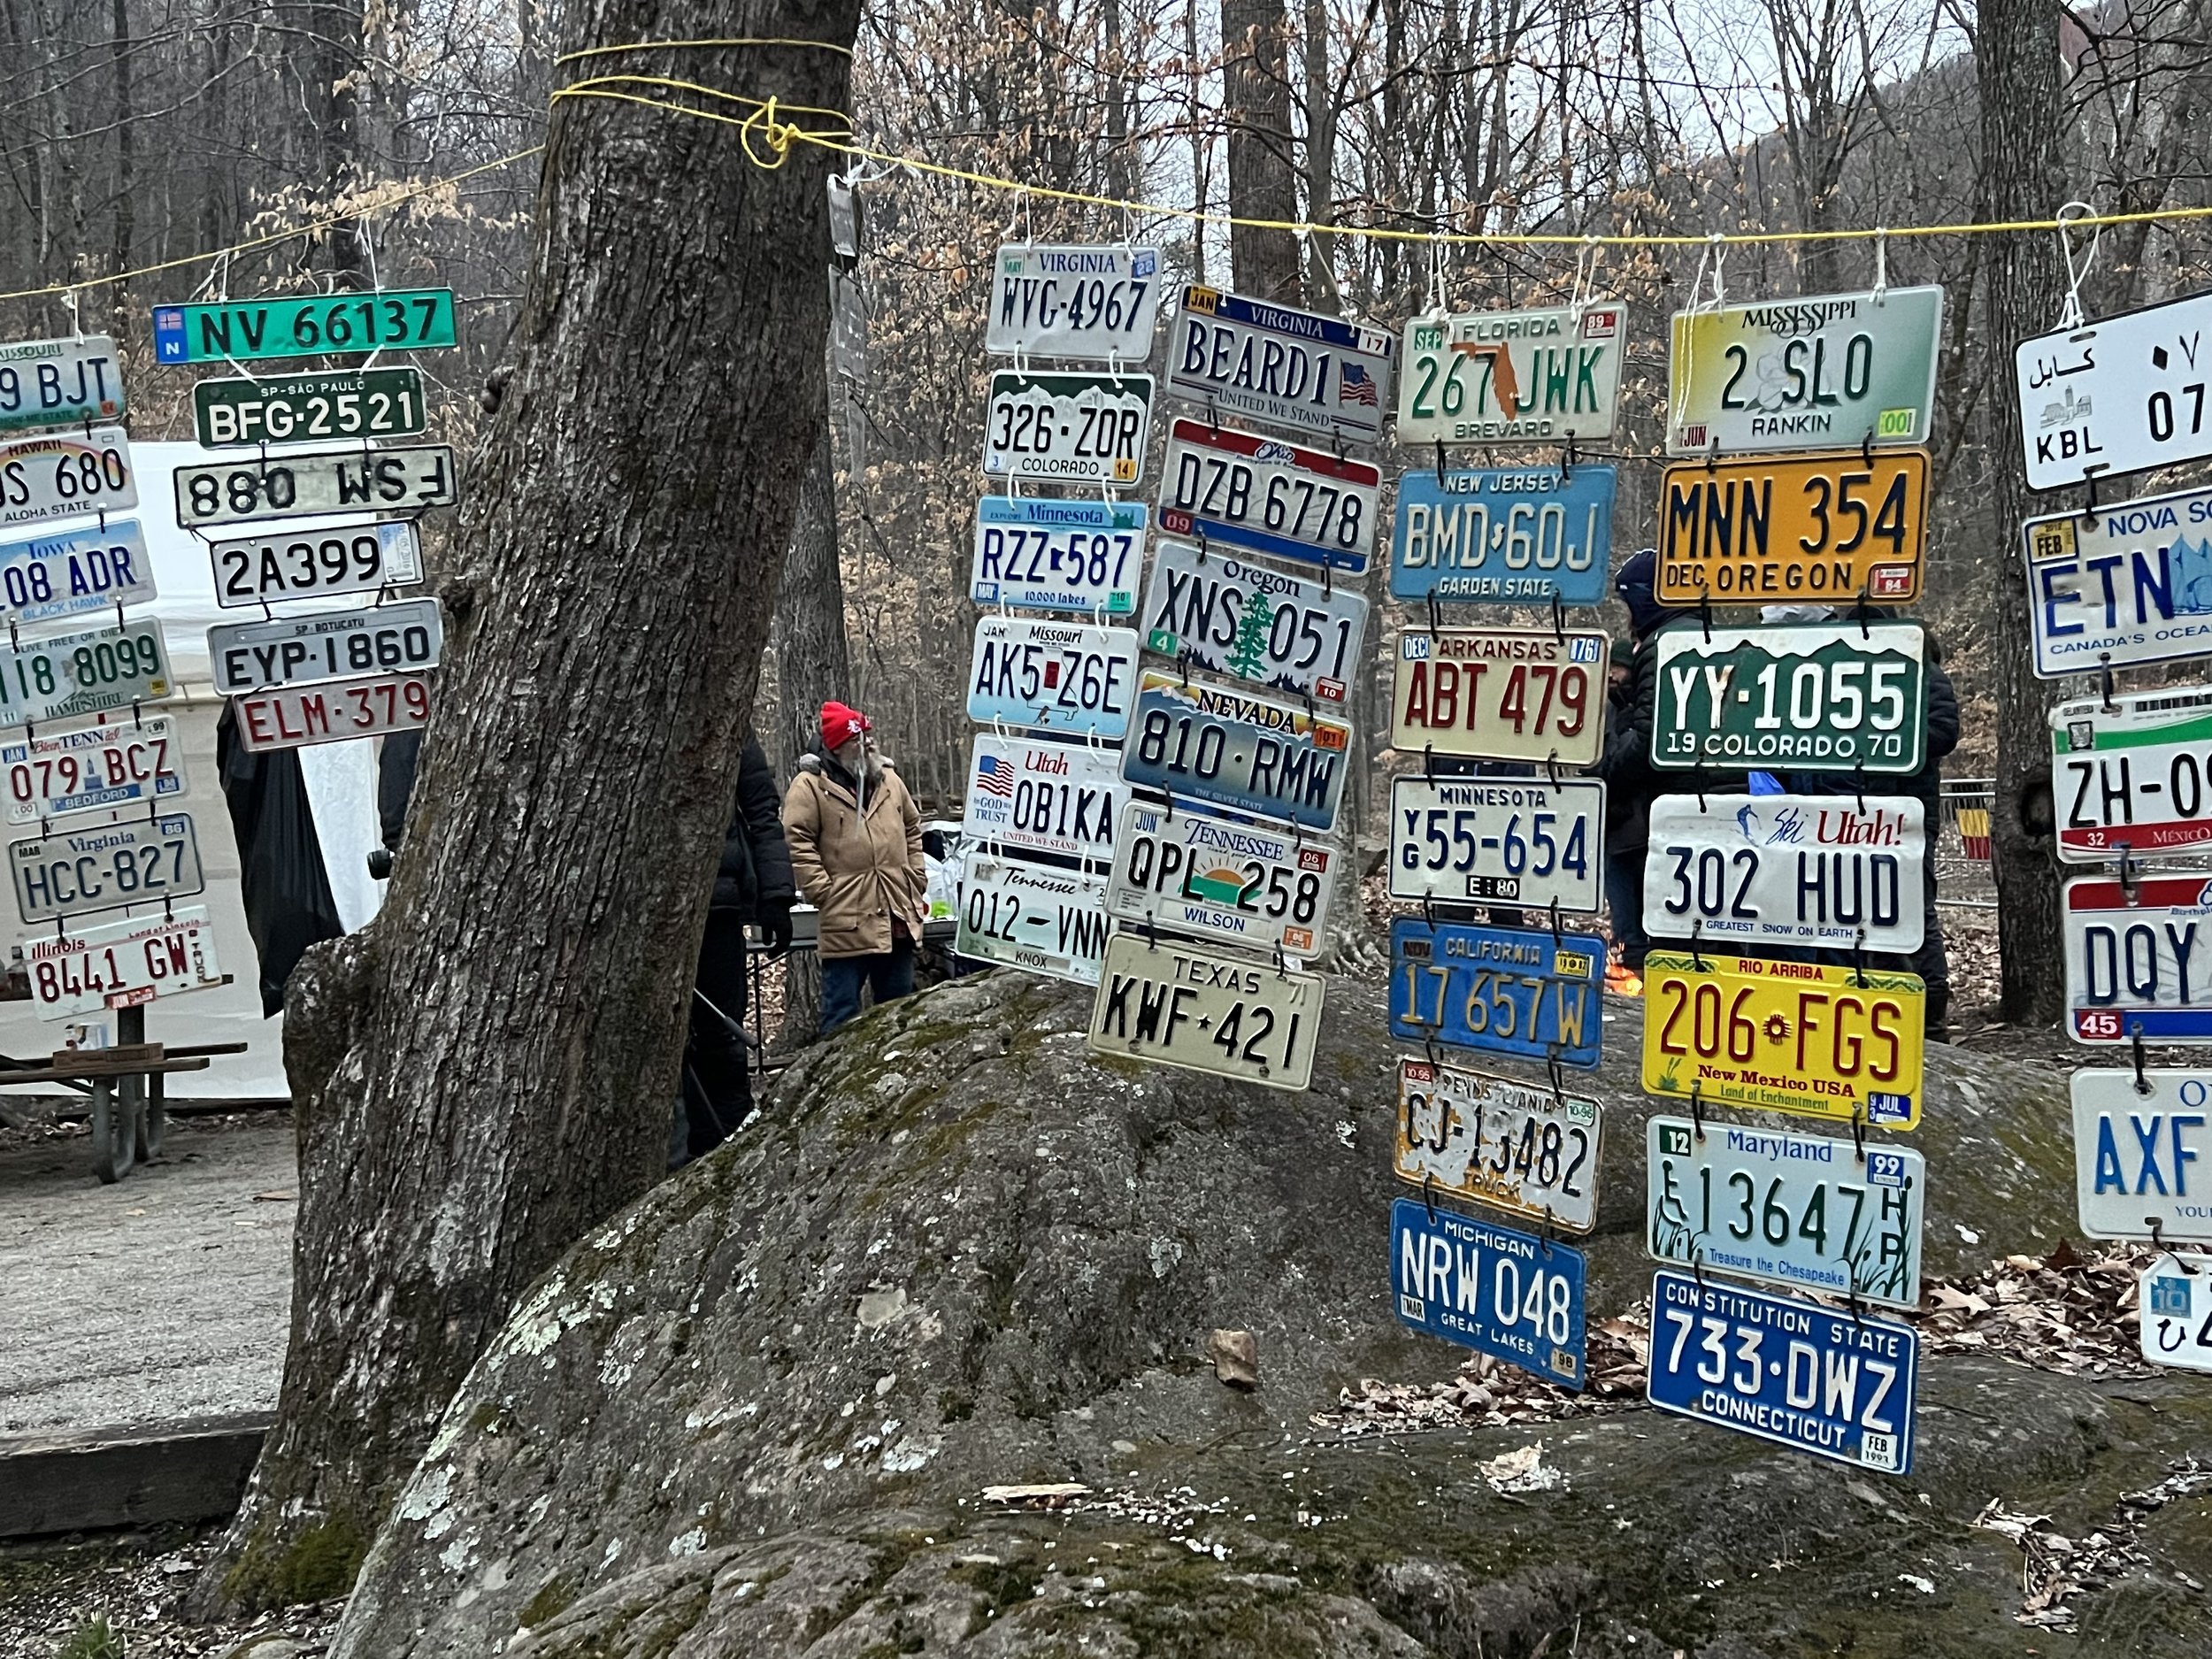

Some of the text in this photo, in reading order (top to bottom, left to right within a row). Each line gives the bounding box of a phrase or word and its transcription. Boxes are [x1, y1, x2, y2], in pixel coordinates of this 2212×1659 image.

[1004, 253, 1116, 274] MAY VIRGINIA
[200, 297, 438, 354] NV 66137
[1190, 293, 1325, 339] JAN VIRGINIA
[1417, 319, 1561, 350] SEP FLORIDA
[1181, 319, 1331, 406] BEARD1
[1515, 342, 1604, 414] JWK
[37, 356, 108, 409] BJT
[321, 381, 365, 394] PAULO
[1218, 389, 1331, 427] UNITED WE STAND
[1455, 419, 1554, 438] BREVARD
[1683, 413, 1832, 448] JUN RANKIN
[2037, 426, 2103, 465] KBL
[8, 440, 61, 457] HAWAII
[1022, 457, 1129, 475] COLORADO 14
[1256, 442, 1294, 461] Ohio
[56, 448, 125, 498] 680
[1445, 472, 1563, 494] NEW JERSEY
[5, 501, 91, 522] ALOHA STATE
[1027, 504, 1103, 524] Minnesota
[1175, 452, 1363, 549] DZB 6778
[1666, 472, 1909, 559] MNN 354
[1166, 515, 1188, 533] 09
[1402, 502, 1490, 569] BMD
[2038, 507, 2177, 557] FEB NOVA
[68, 546, 136, 596] ADR
[222, 535, 380, 596] 2A399
[982, 528, 1133, 588] RZZ 587
[1224, 560, 1301, 599] Oregon
[1439, 577, 1553, 597] GARDEN STATE
[1717, 560, 1852, 593] OREGON
[2040, 547, 2174, 637] ETN
[23, 595, 107, 620] BLACK HAWK
[1025, 590, 1086, 605] 10,000 lakes
[19, 626, 120, 654] LIVE FREE OR DIE
[983, 625, 1083, 644] JAN Missouri
[1154, 567, 1351, 679] XNS 051
[73, 635, 159, 687] 8099
[1156, 637, 1168, 655] 4
[1404, 638, 1557, 660] DEC ARKANSAS
[2050, 633, 2145, 655] CANADA'S
[976, 641, 1128, 714] AK5 Z6E
[44, 694, 123, 718] HAMPSHIRE
[1195, 688, 1296, 736] NEVADA
[1404, 660, 1588, 737] ABT 479
[6, 747, 27, 762] JAN
[1025, 750, 1069, 776] Utah
[1666, 732, 1857, 759] 19 COLORADO
[12, 738, 173, 802] 079 BCZ
[65, 787, 128, 810] BEDFORD
[980, 796, 1002, 813] GOD
[1194, 787, 1263, 812] THE SILVER STATE
[1440, 786, 1548, 807] MINNESOTA
[975, 808, 1008, 826] TRUST
[1765, 806, 1906, 847] Ski Utah!
[67, 831, 135, 852] Virginia
[165, 822, 184, 834] 86
[1003, 831, 1078, 850] UNITED STAND
[1136, 813, 1156, 833] JUN
[1184, 818, 1284, 861] TENNESSEE
[1303, 850, 1319, 864] 06
[1426, 807, 1587, 879] 55-654
[2087, 826, 2211, 847] 32 MÉXICO
[1003, 866, 1078, 895] Tennessee
[1128, 836, 1321, 924] QPL 258
[1664, 846, 1901, 926] 302 HUD
[1184, 906, 1246, 932] WILSON
[1706, 919, 1855, 941] GREATEST SNOW ON EARTH
[31, 938, 85, 959] Illinois
[1015, 950, 1048, 969] KNOX
[1446, 937, 1541, 966] CALIFORNIA
[2085, 922, 2197, 1007] DQY
[36, 946, 126, 1003] 8441
[143, 933, 188, 979] GW
[1172, 955, 1307, 1006] TEXAS 71
[1738, 958, 1824, 980] RIO ARRIBA
[1102, 973, 1299, 1069] KWF 421
[1661, 979, 1903, 1082] 206 FGS
[2080, 1014, 2117, 1034] 45
[1698, 1063, 1856, 1099] New Mexico USA
[1720, 1082, 1902, 1113] Land of Enchantment JUL
[1568, 1105, 1594, 1122] 10-96
[1667, 1129, 1900, 1177] 12 Maryland 99
[2094, 1115, 2206, 1197] AXF
[1700, 1164, 1869, 1261] 13647
[1445, 1220, 1535, 1260] MICHIGAN
[1708, 1248, 1844, 1286] Treasure the Chesapeake
[1402, 1227, 1571, 1346] NRW 048
[1440, 1311, 1535, 1356] GREAT LAKES
[1666, 1282, 1899, 1358] CONSTITUTION STATE
[1701, 1389, 1888, 1453] CONNECTICUT FEB
